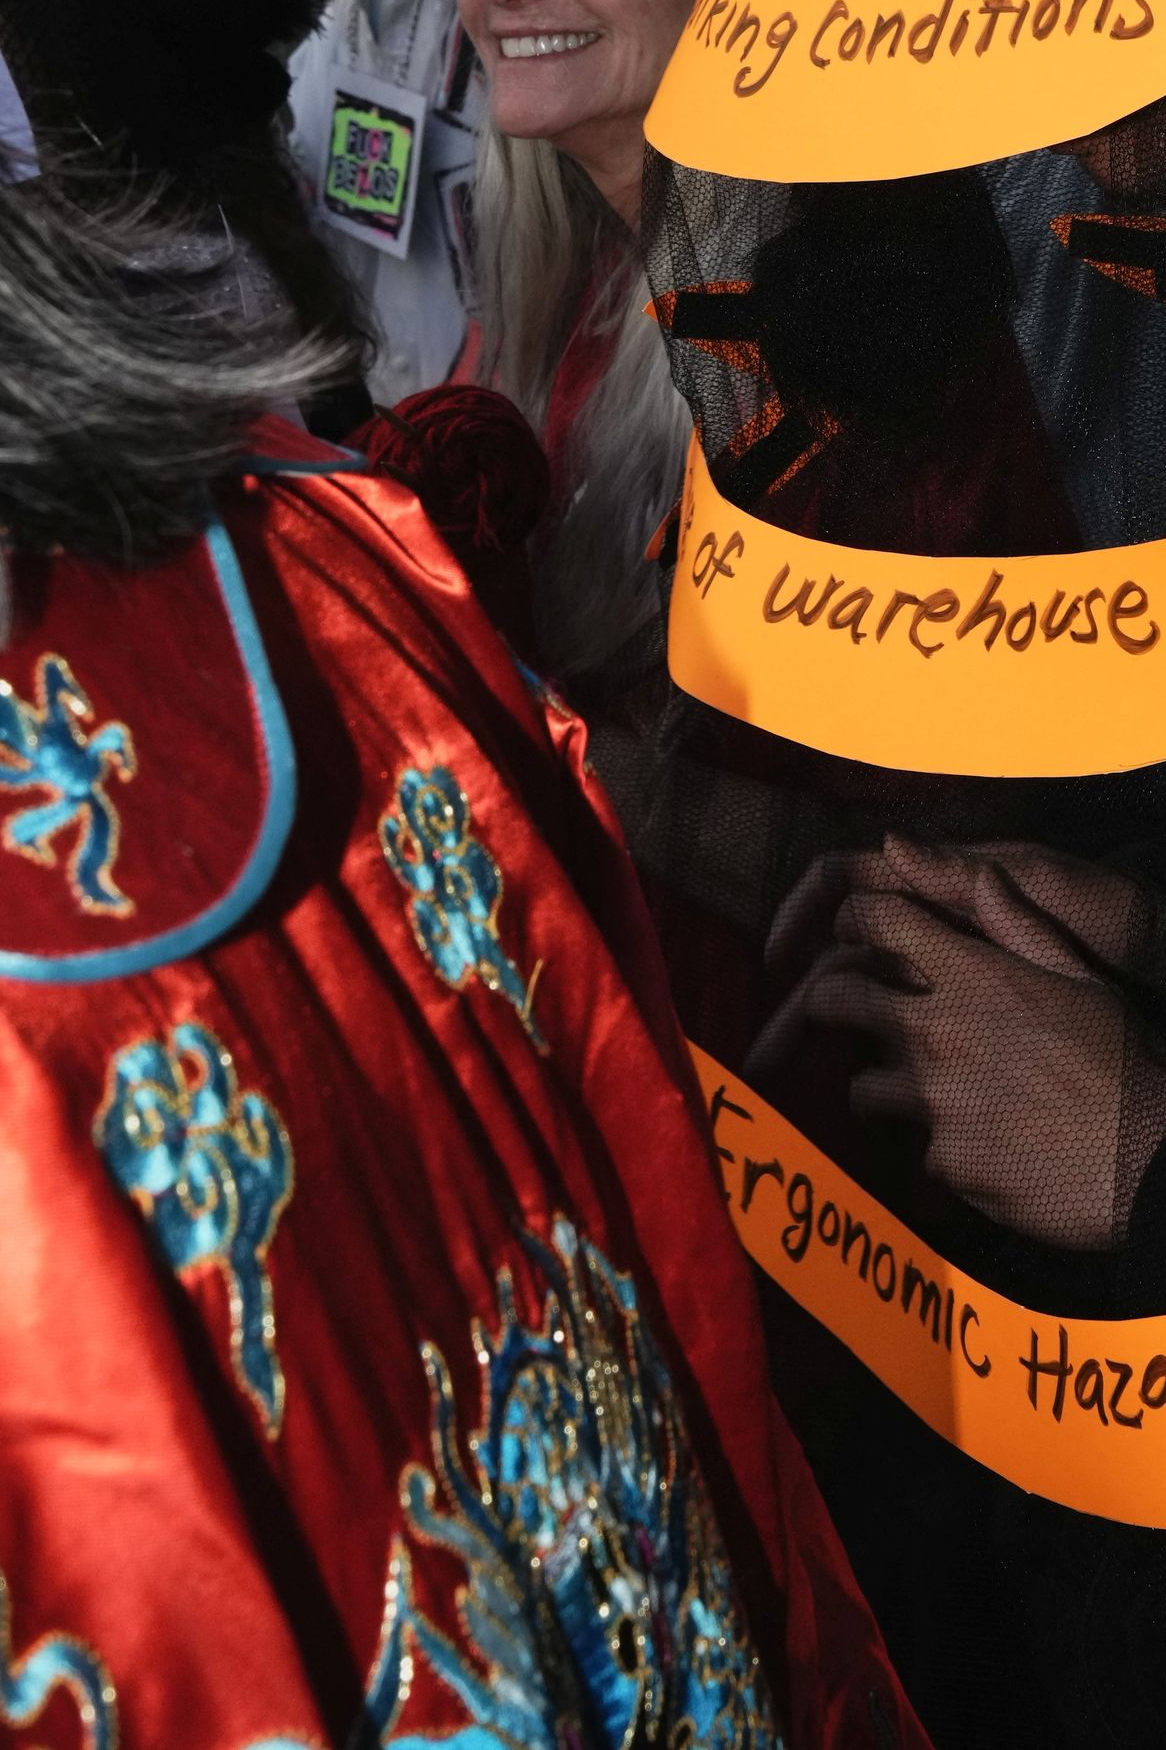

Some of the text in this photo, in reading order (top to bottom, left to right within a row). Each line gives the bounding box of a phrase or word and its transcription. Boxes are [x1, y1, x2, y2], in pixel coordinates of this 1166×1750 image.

[333, 155, 399, 200] BEZOS
[345, 119, 394, 165] FUCK
[692, 530, 744, 600] of
[762, 561, 1160, 659] warehouse
[710, 1084, 992, 1378] Ergonomic
